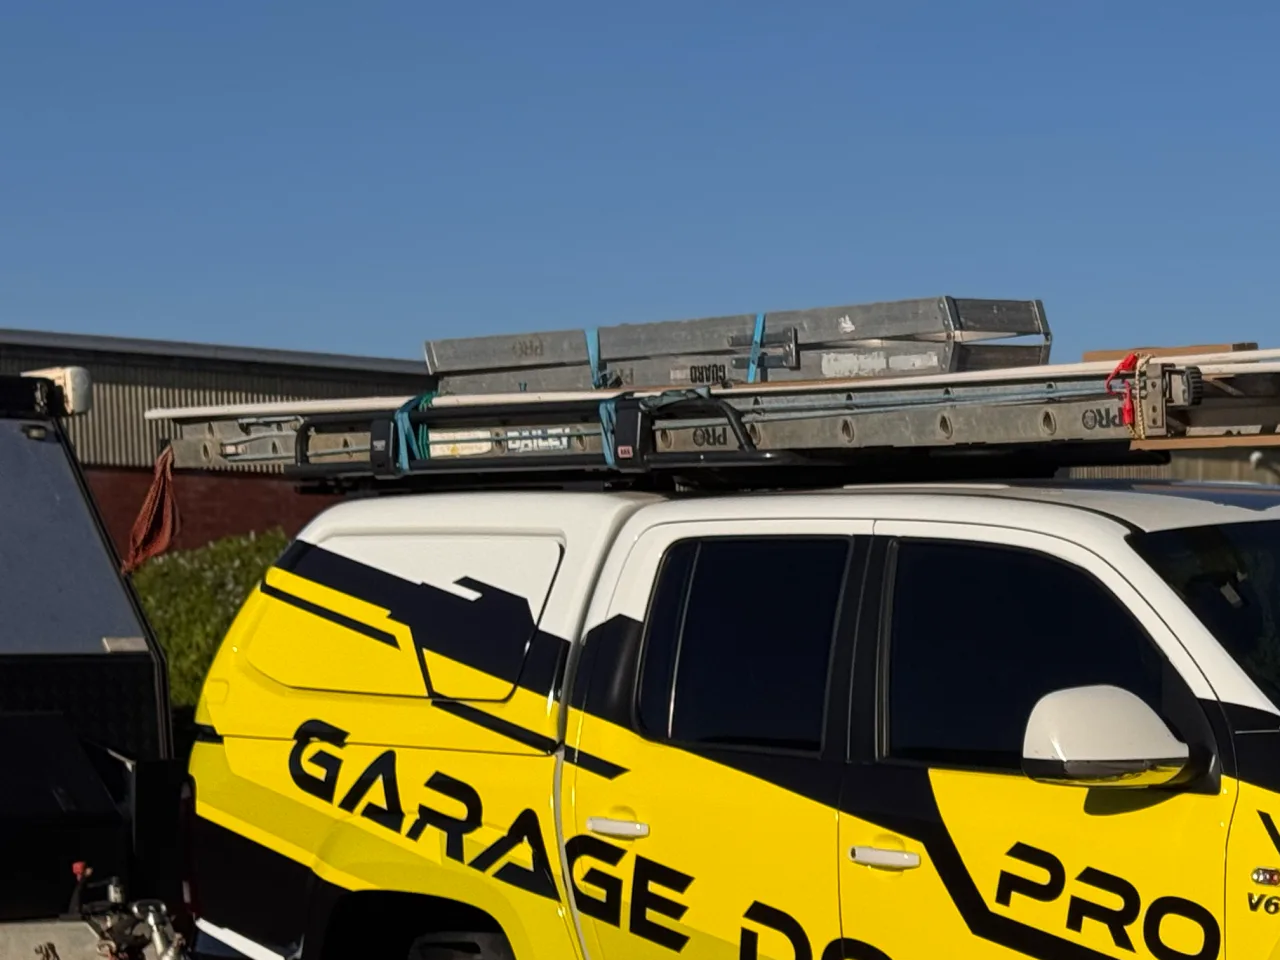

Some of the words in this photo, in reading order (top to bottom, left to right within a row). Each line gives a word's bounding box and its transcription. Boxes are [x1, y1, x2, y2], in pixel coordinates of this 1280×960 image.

[1082, 408, 1124, 431] PRO
[506, 427, 572, 454] BAILEY
[693, 426, 728, 447] PRO
[288, 719, 696, 953] GARAGE
